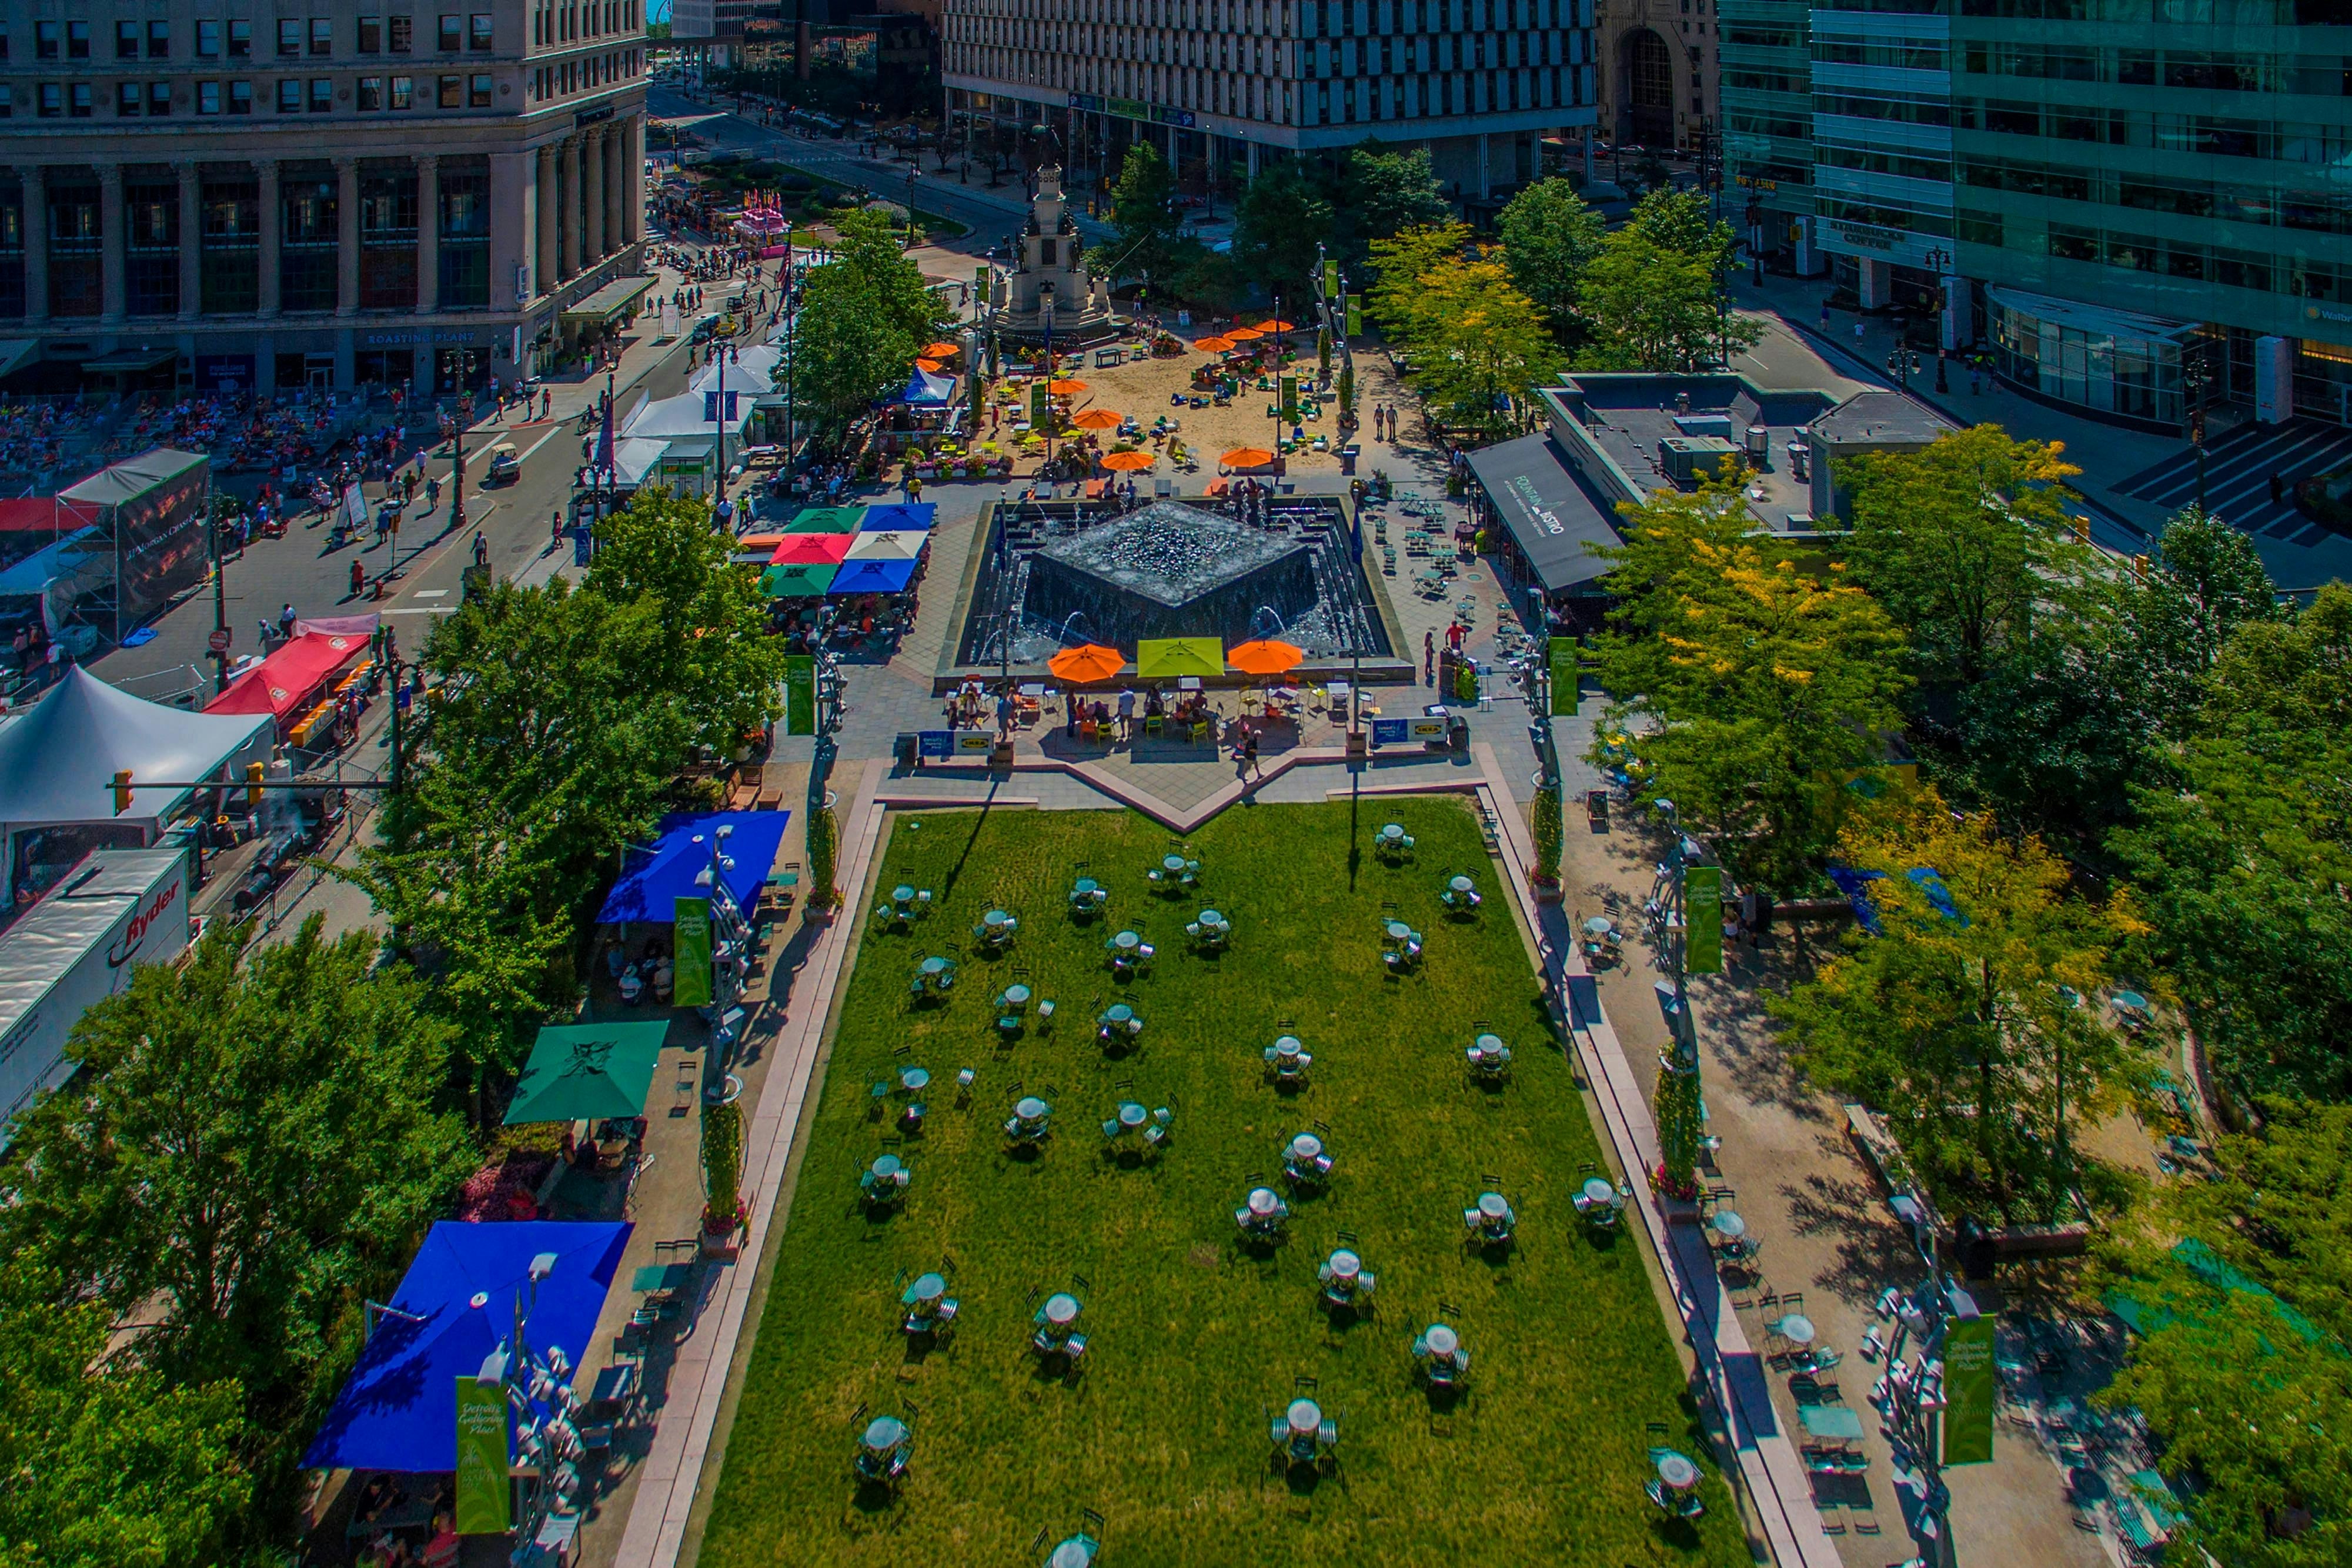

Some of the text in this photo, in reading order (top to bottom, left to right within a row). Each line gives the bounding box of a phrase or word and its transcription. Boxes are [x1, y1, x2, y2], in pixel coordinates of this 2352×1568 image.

[1830, 220, 1905, 242] STARBUCKS
[1844, 234, 1891, 250] COFFEE
[368, 332, 475, 345] ROASTING PLANT
[1515, 476, 1564, 534] FOUNTAIN BISTRO
[126, 880, 179, 948] Ryder
[462, 1403, 503, 1414] Detroit's
[459, 1413, 506, 1427] Gathering
[469, 1425, 496, 1435] Place
